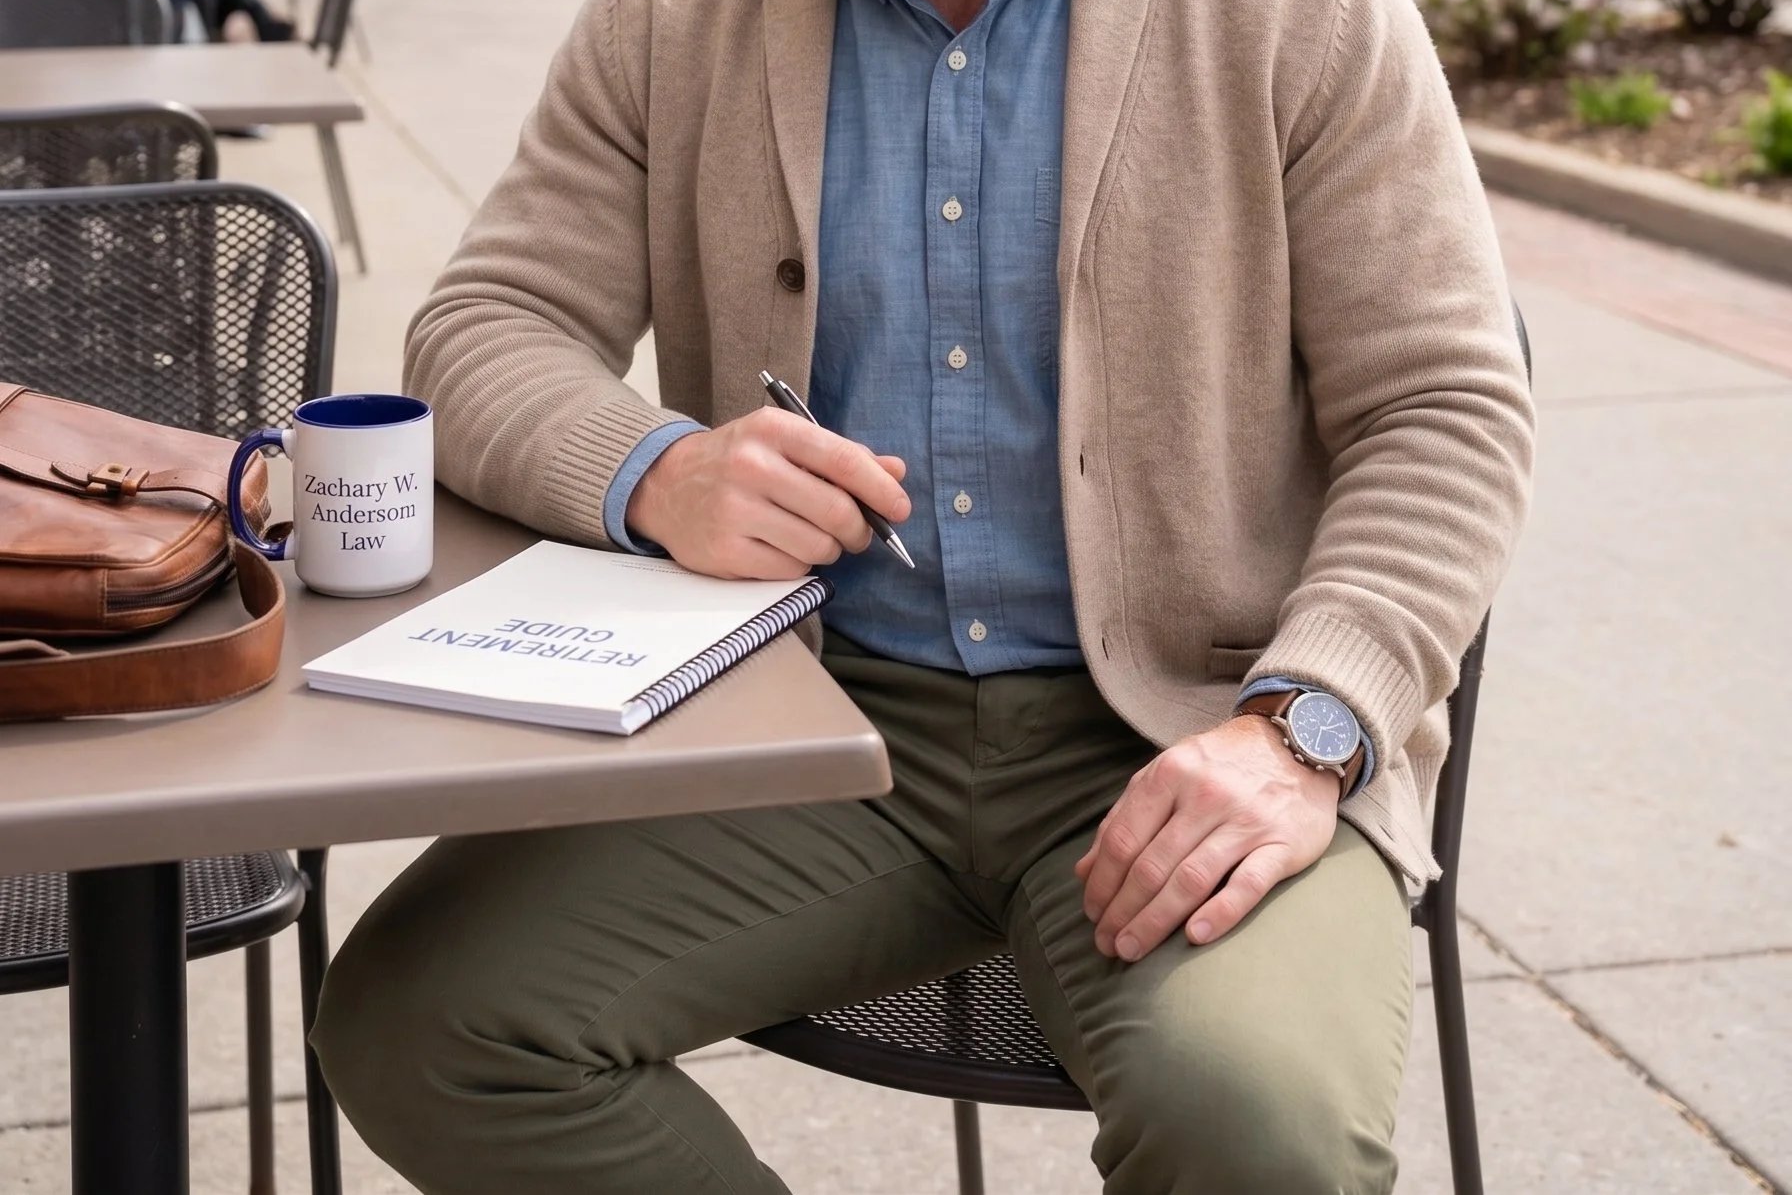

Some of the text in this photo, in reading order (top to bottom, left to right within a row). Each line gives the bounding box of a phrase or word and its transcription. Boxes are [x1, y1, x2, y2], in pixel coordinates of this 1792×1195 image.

[304, 472, 418, 502] Zachary W.
[311, 503, 416, 523] Andersom
[340, 532, 387, 551] Law
[494, 619, 615, 643] GUIDE
[408, 627, 648, 668] RETIREMENT
